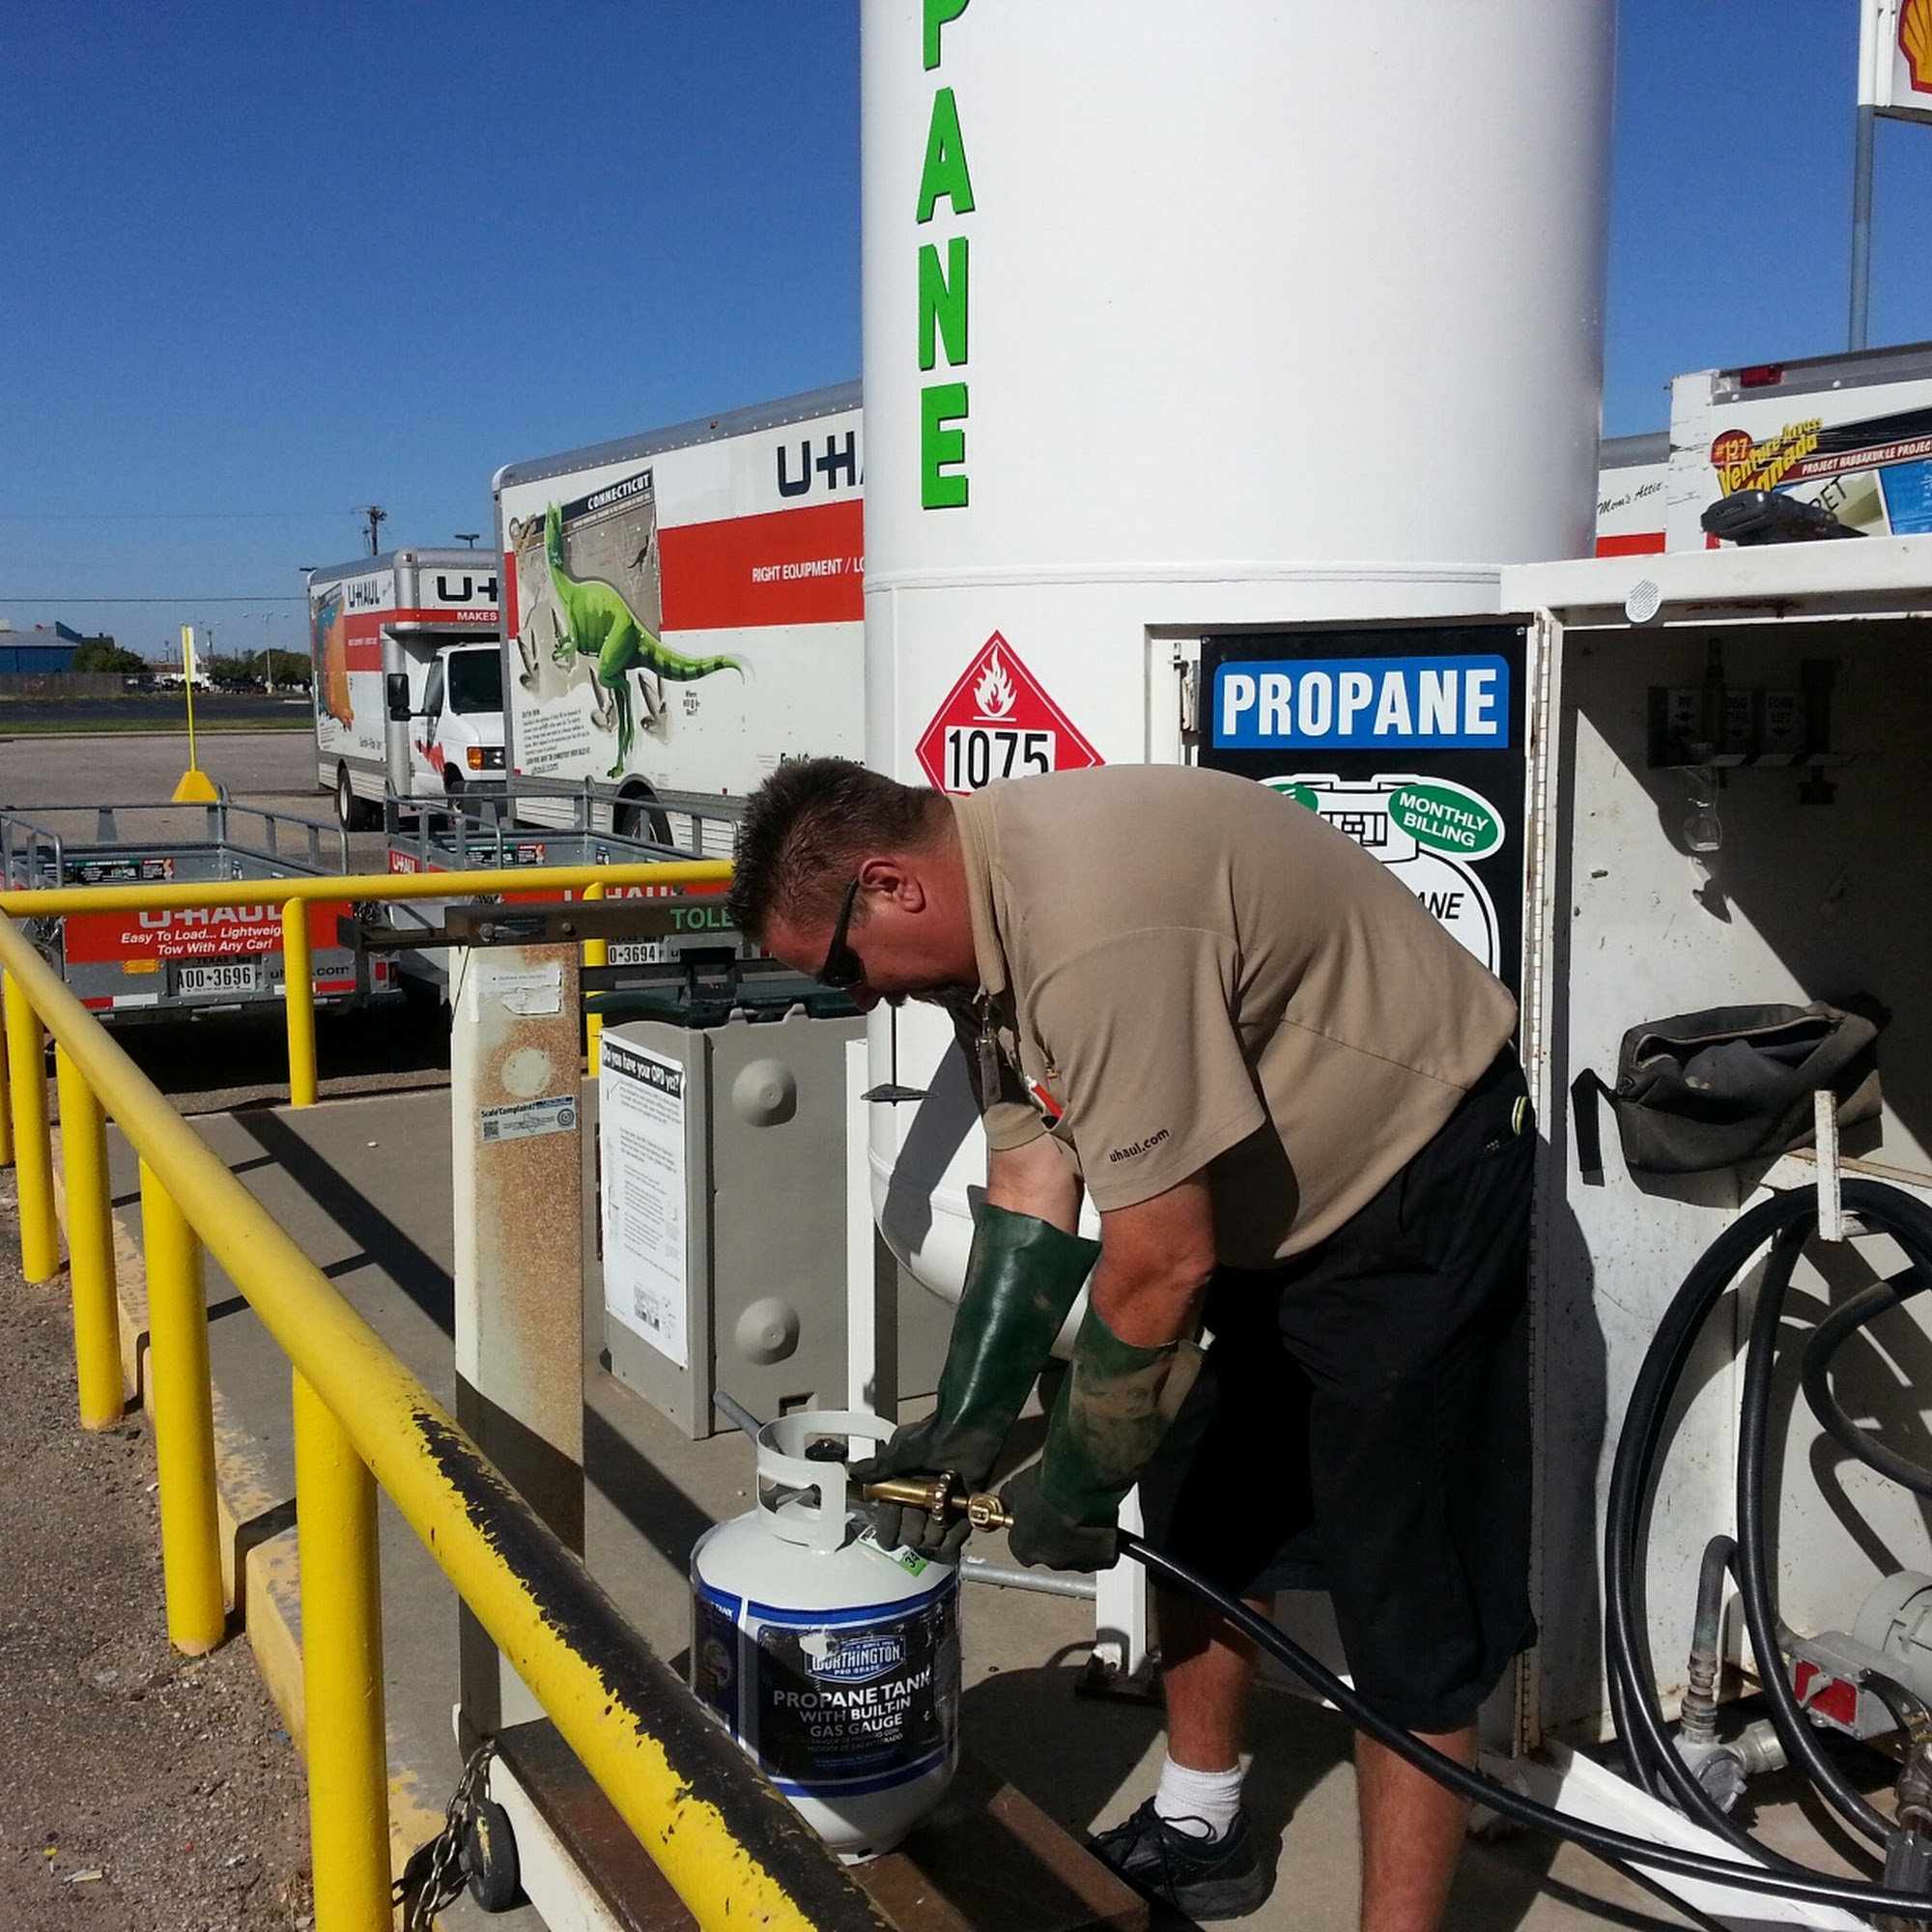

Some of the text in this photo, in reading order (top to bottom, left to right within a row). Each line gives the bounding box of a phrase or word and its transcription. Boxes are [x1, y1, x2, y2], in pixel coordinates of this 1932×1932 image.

[1717, 436, 1780, 497] Venture
[1747, 434, 1818, 492] anada
[1802, 458, 1839, 475] PROJECT
[1885, 446, 1896, 460] LE
[1897, 440, 1932, 457] PROJEC
[587, 473, 650, 511] CONNECTICUT
[1598, 481, 1663, 516] Mom's Attic
[753, 565, 781, 582] RIGHT
[782, 557, 843, 580] EQUIPMENT
[348, 580, 381, 609] U-HAUL
[457, 611, 497, 622] MAKES
[1222, 668, 1497, 737] PROPANE
[949, 729, 1049, 790] 1075
[1400, 792, 1489, 833] MONTHLY
[1403, 811, 1476, 848] BILLING
[122, 924, 284, 946] Easy To Load... Lightweig
[157, 938, 272, 956] Tow With Any Car!
[623, 1052, 636, 1074] have
[637, 1062, 651, 1079] your
[481, 1109, 497, 1118] Scale
[1109, 1127, 1171, 1163] uhaul.com
[812, 1645, 900, 1671] WORTHINGTON
[773, 1663, 932, 1709] PROPANE TANK
[799, 1694, 911, 1723] WITH BUILT-IN
[810, 1712, 903, 1738] GAS GAUGE
